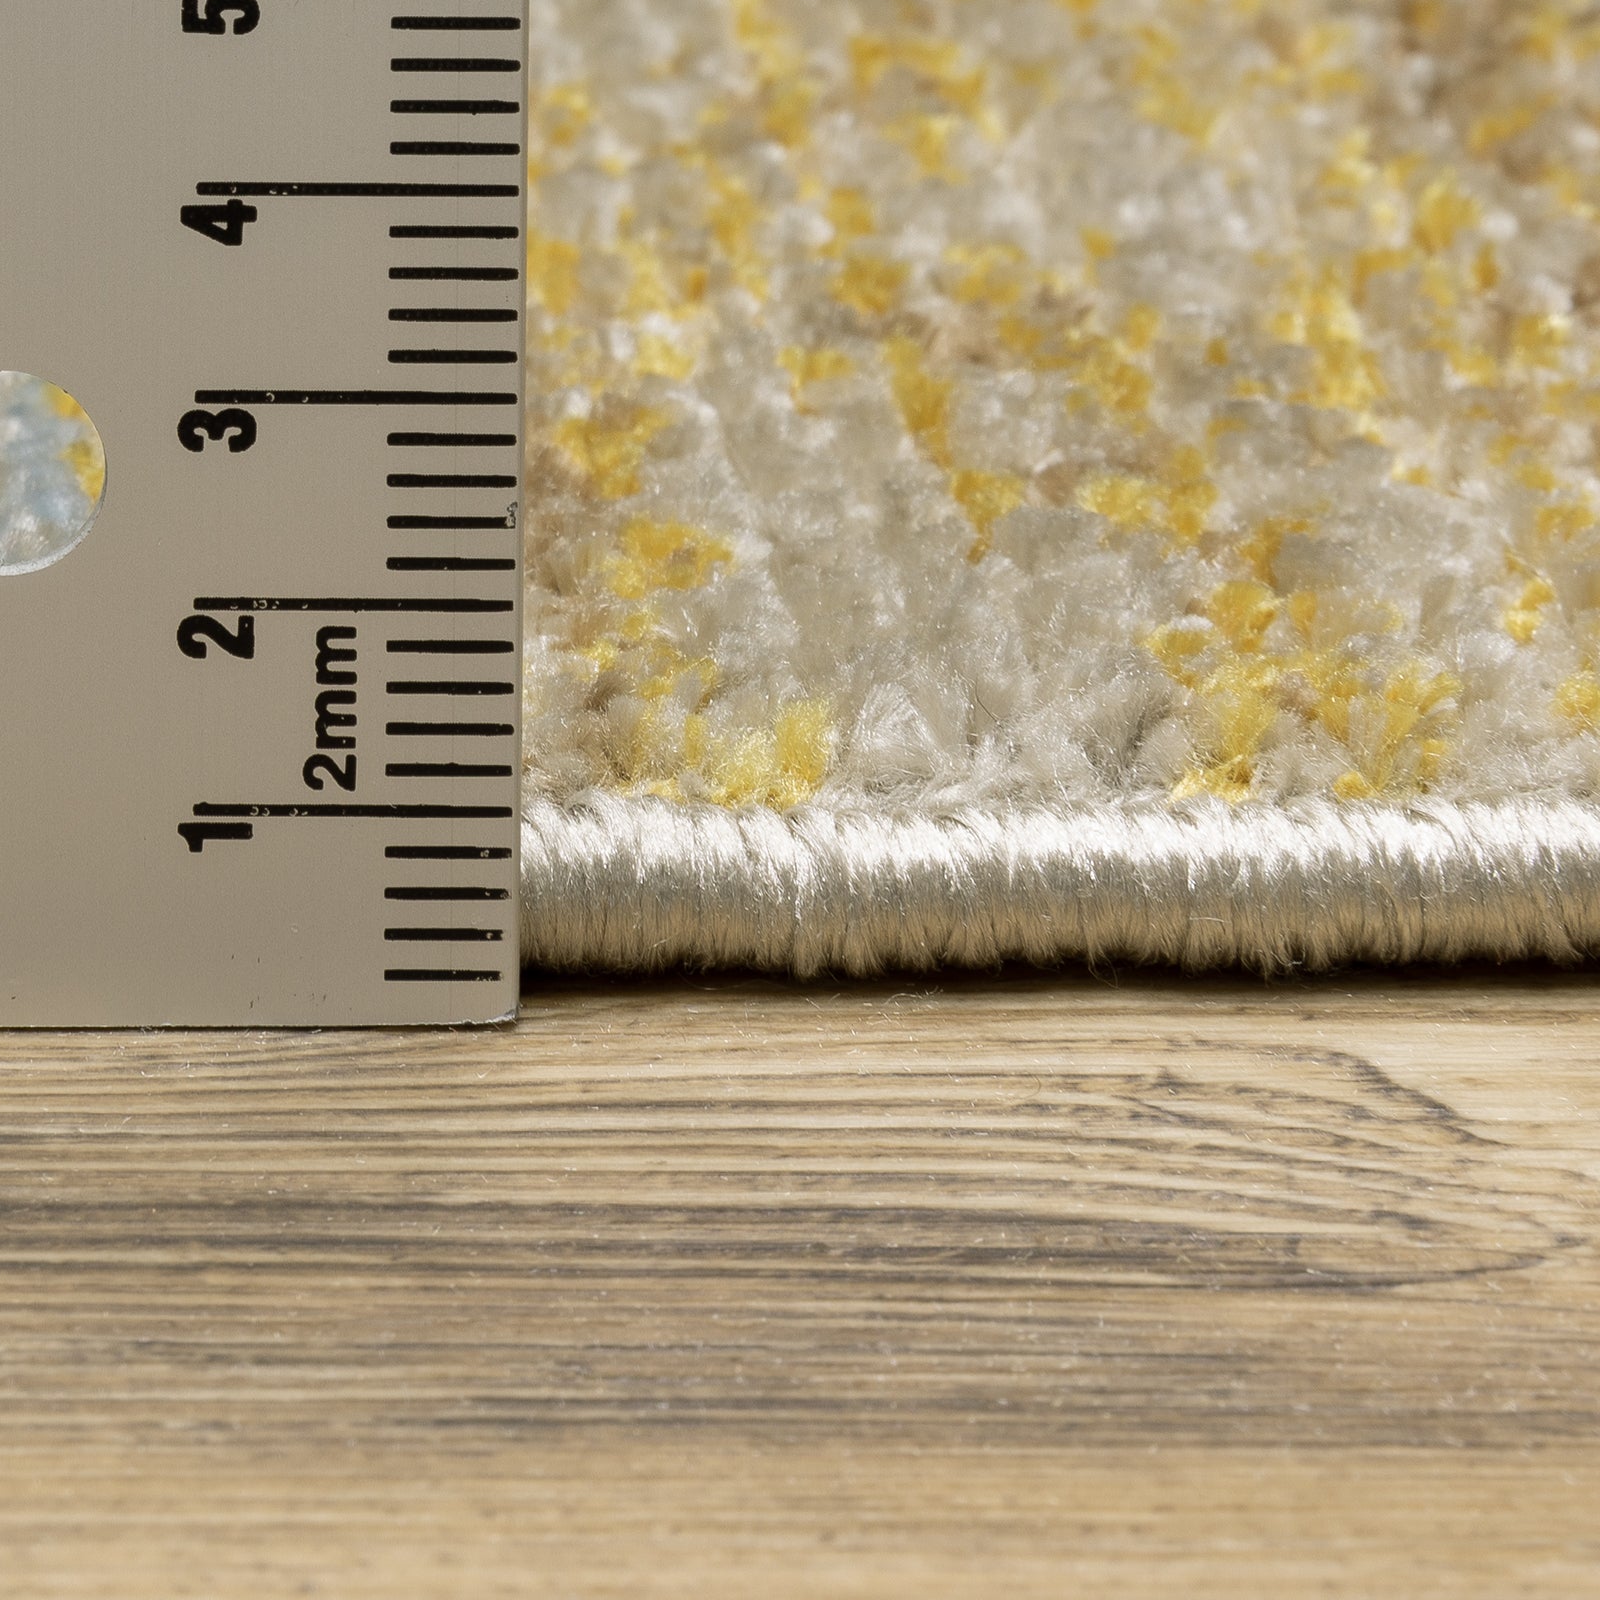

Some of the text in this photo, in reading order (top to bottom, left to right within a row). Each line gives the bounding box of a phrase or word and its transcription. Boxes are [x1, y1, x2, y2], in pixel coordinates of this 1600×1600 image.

[180, 198, 258, 246] 4
[177, 407, 257, 453] 3
[176, 614, 255, 660] 2
[302, 625, 358, 792] 2mm
[177, 821, 254, 853] 1
